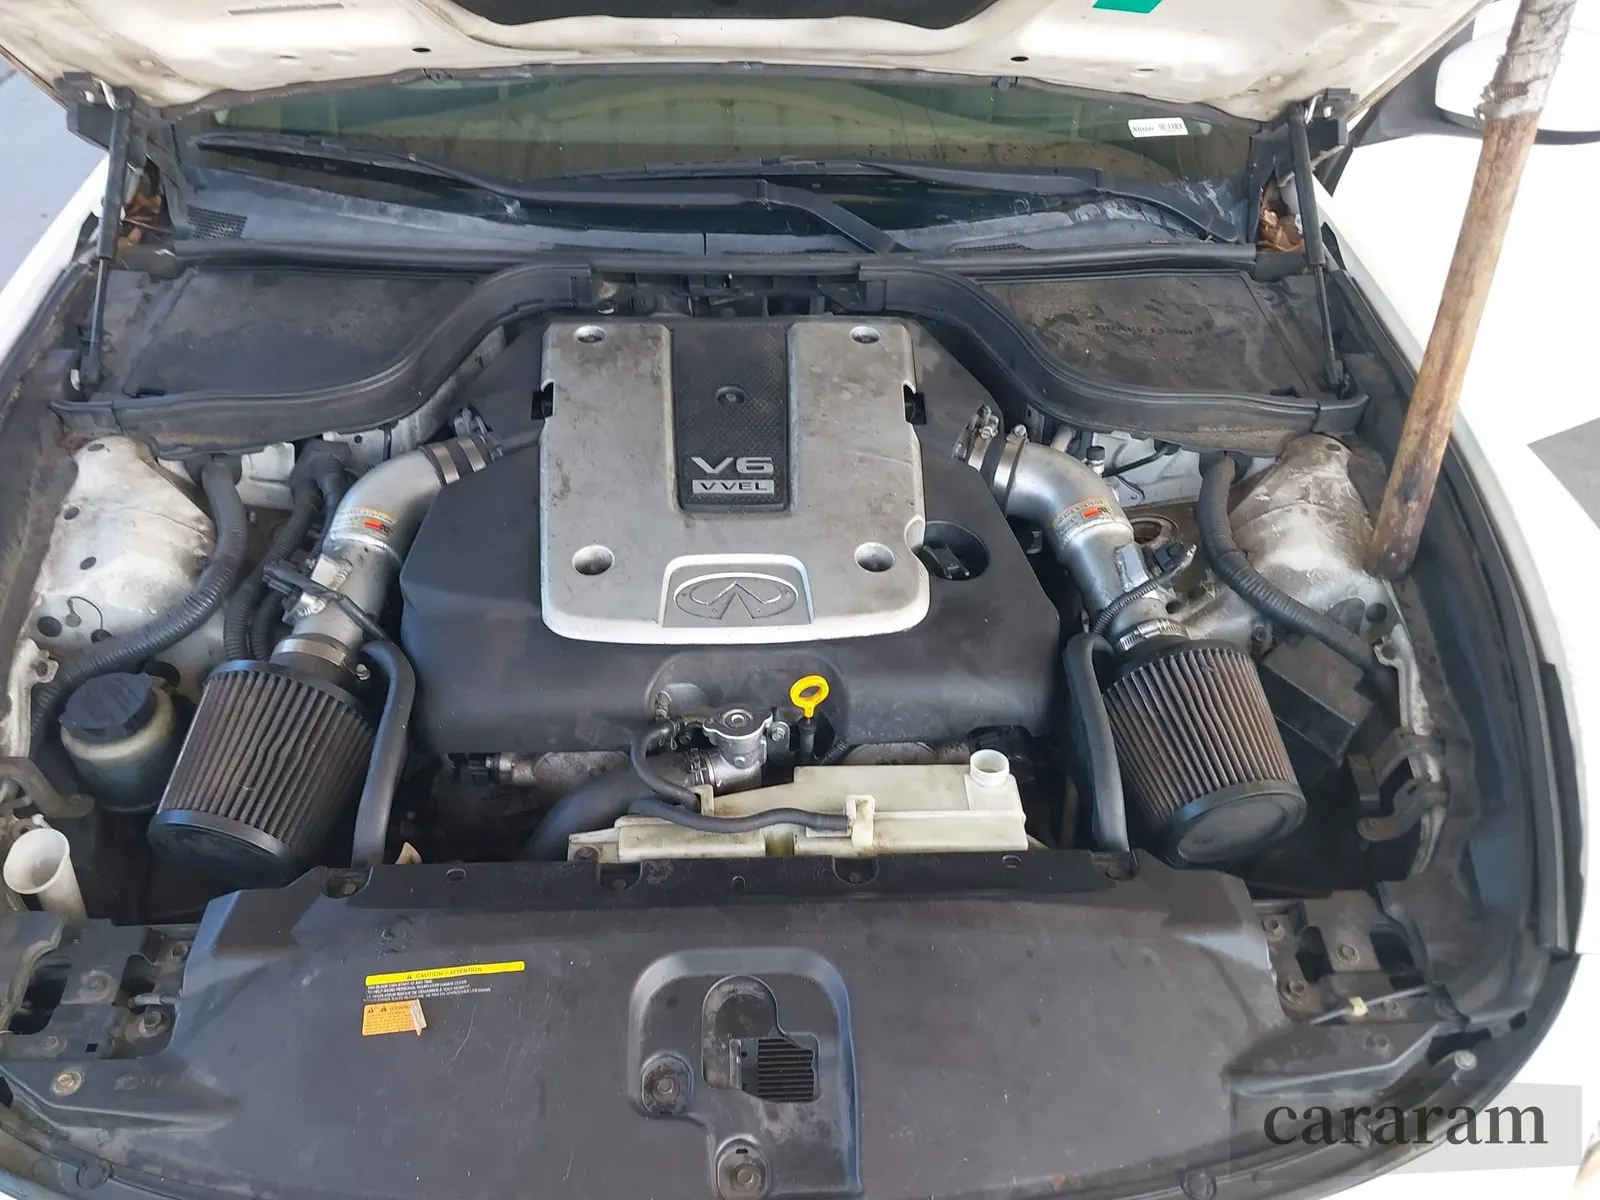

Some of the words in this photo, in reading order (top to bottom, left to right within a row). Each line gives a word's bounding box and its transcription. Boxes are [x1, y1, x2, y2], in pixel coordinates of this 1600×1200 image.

[691, 457, 775, 476] V6
[699, 481, 768, 492] VVEL
[415, 971, 444, 979] CAUTION
[448, 968, 483, 976] ATTENTION
